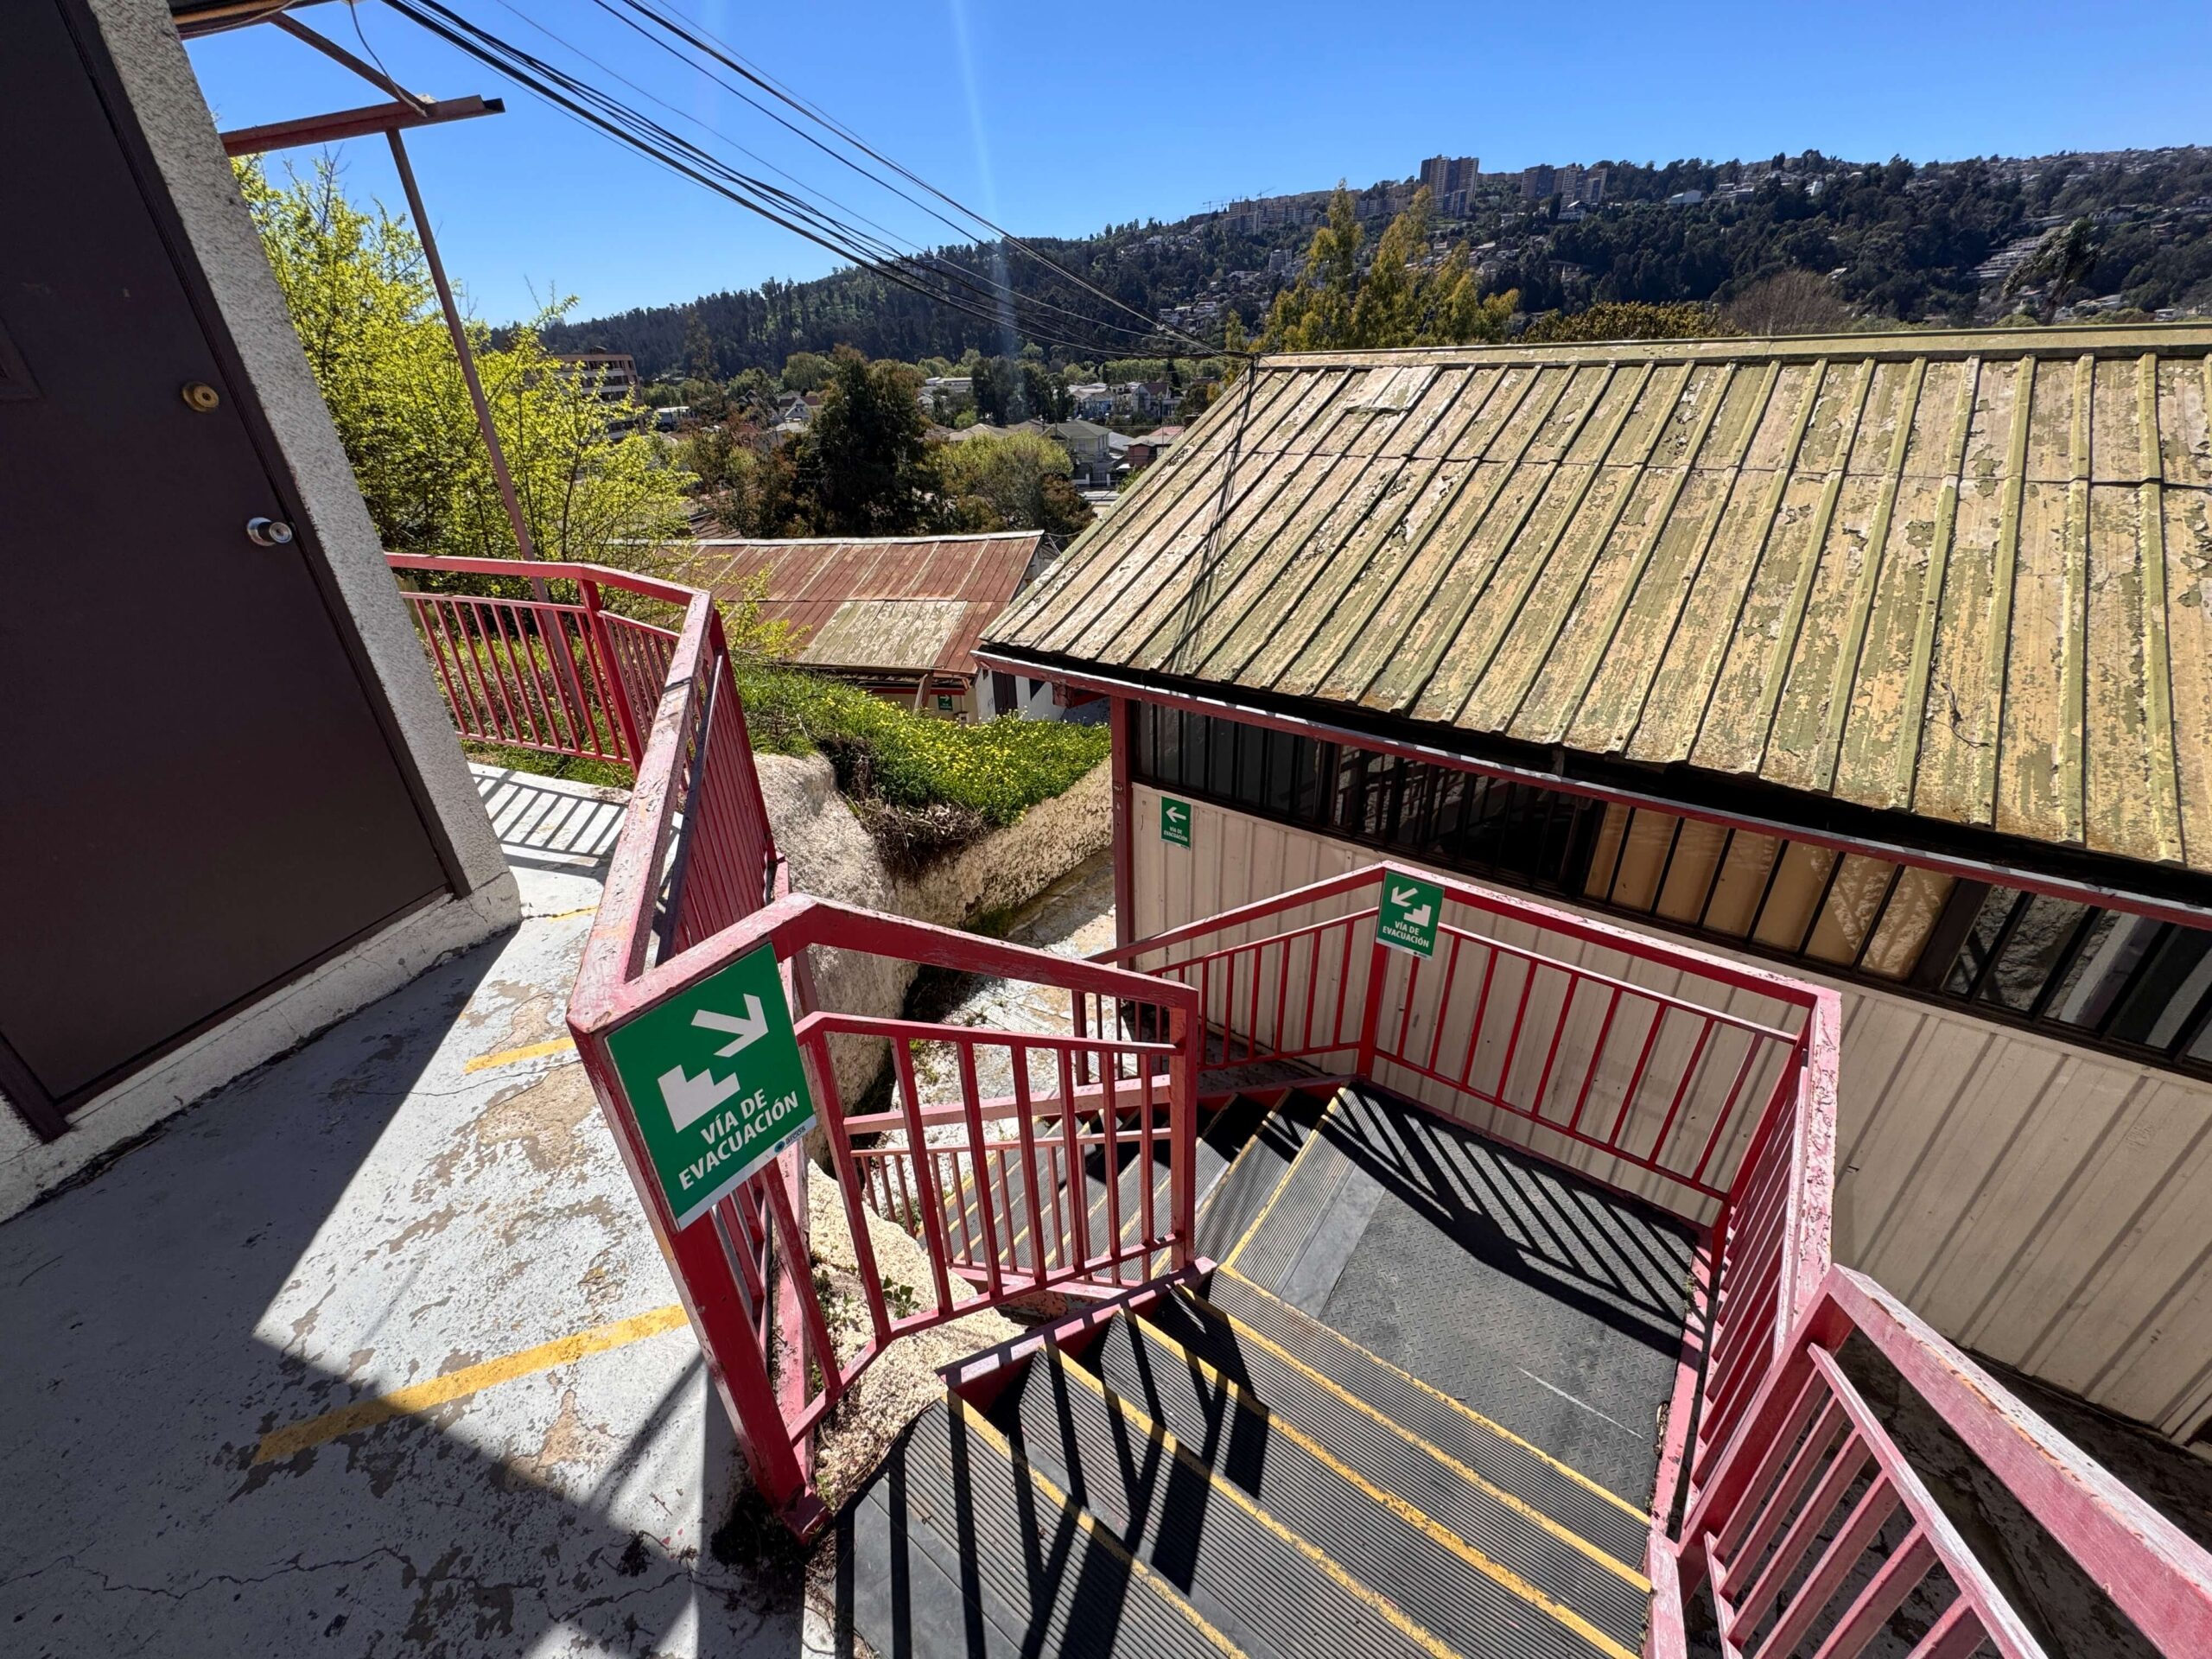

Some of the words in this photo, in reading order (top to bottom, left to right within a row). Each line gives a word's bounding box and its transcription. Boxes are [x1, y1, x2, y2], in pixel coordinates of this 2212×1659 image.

[1382, 925, 1429, 948] EVACUACIÓN
[1395, 920, 1408, 931] VÍA
[1409, 925, 1420, 936] DE
[700, 1110, 739, 1145] VÍA
[740, 1088, 767, 1119] DE
[678, 1090, 798, 1191] EVACUACIÓN
